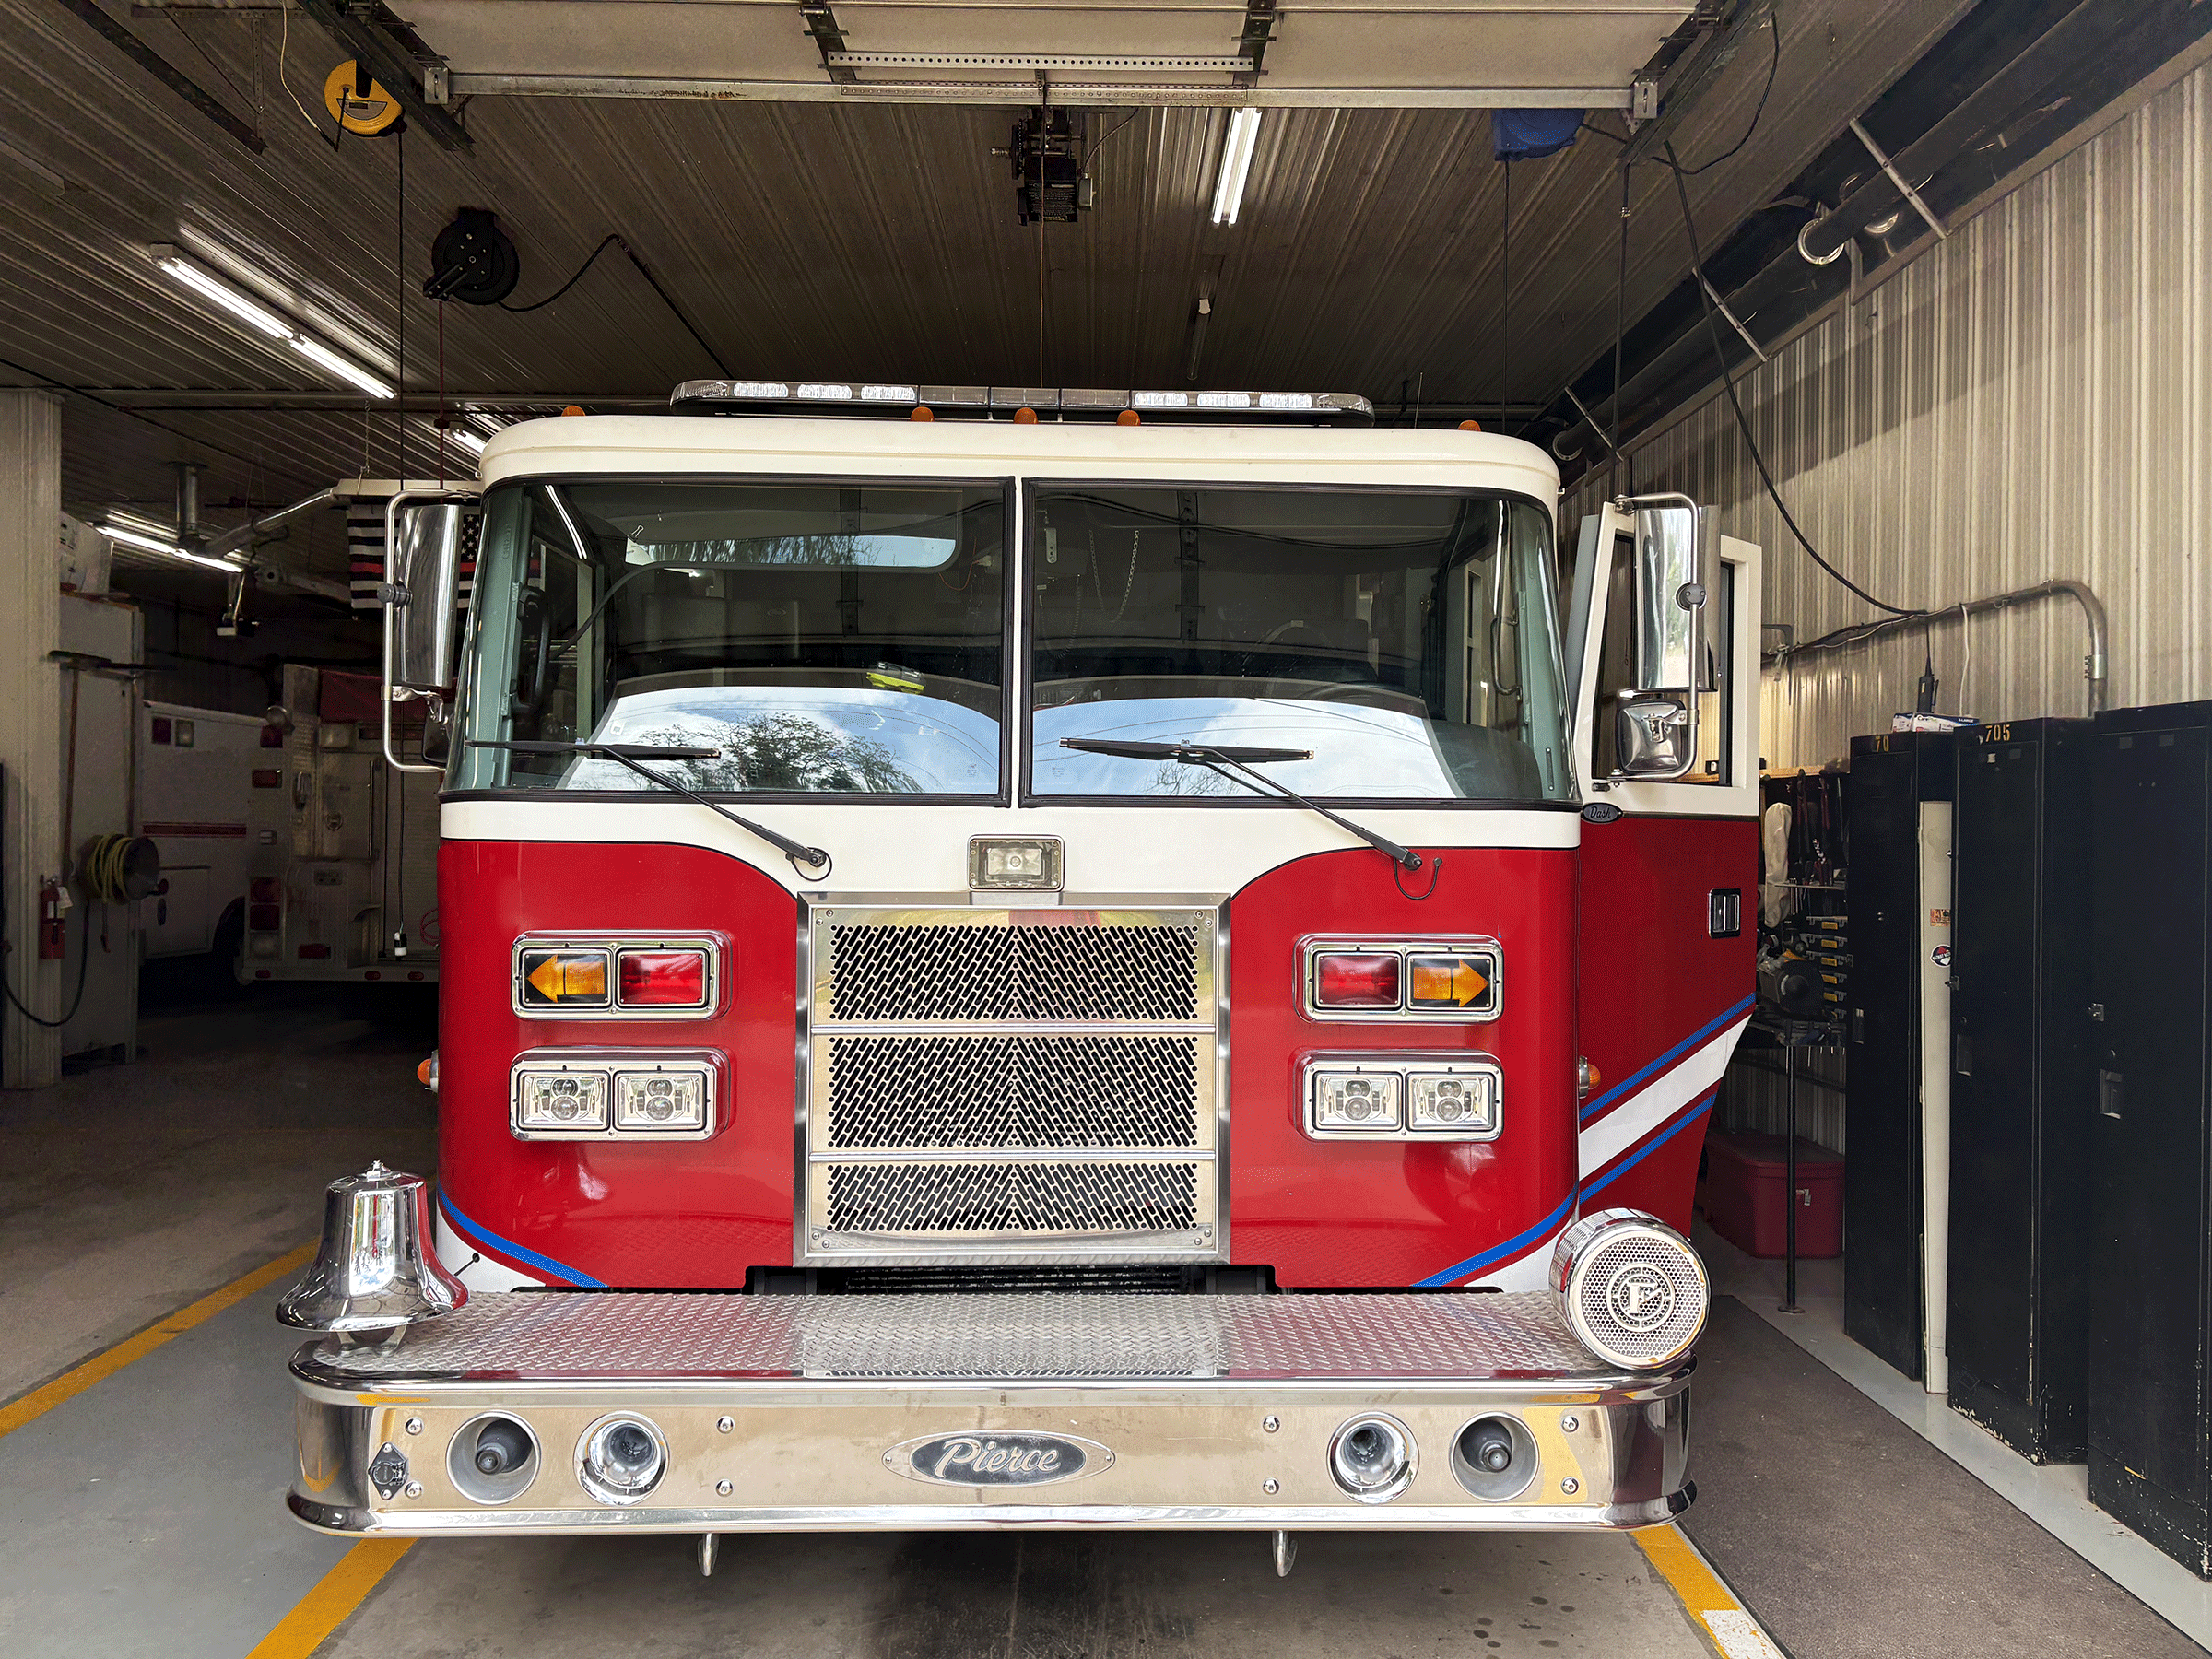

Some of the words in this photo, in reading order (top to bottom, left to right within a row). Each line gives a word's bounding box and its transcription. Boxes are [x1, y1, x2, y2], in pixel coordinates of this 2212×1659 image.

[1985, 724, 2011, 743] 705
[1590, 806, 1611, 819] Dash
[934, 1437, 1062, 1479] Pierce
